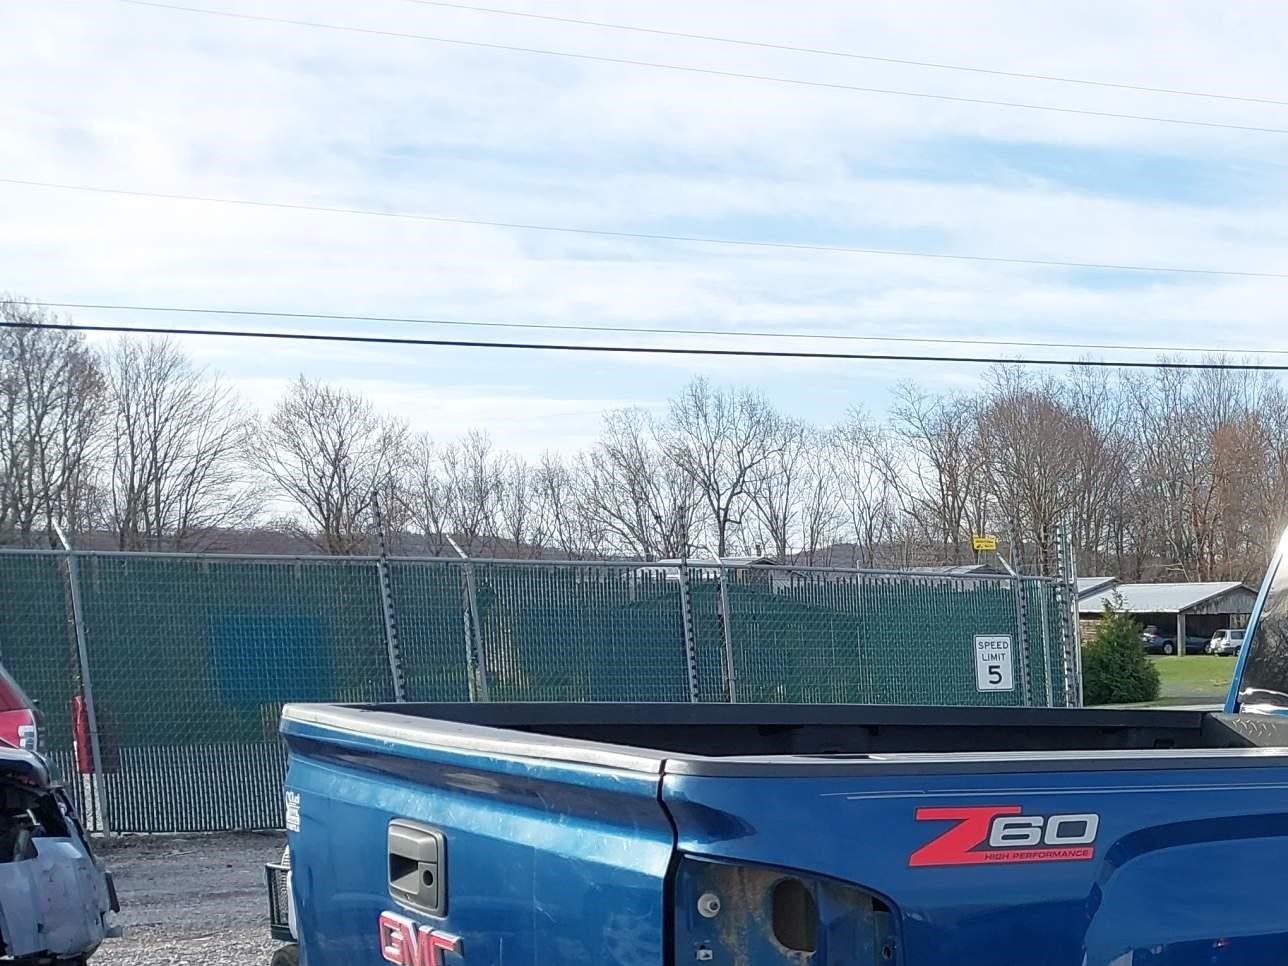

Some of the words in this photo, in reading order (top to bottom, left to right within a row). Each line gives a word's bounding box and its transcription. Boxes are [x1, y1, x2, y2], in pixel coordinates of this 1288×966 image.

[978, 641, 1009, 650] SPEED
[982, 653, 1006, 662] LIMIT
[988, 665, 1003, 685] 5
[909, 805, 1100, 867] Z60
[984, 853, 1010, 861] HIGH
[1012, 849, 1089, 860] PERFORMANCE
